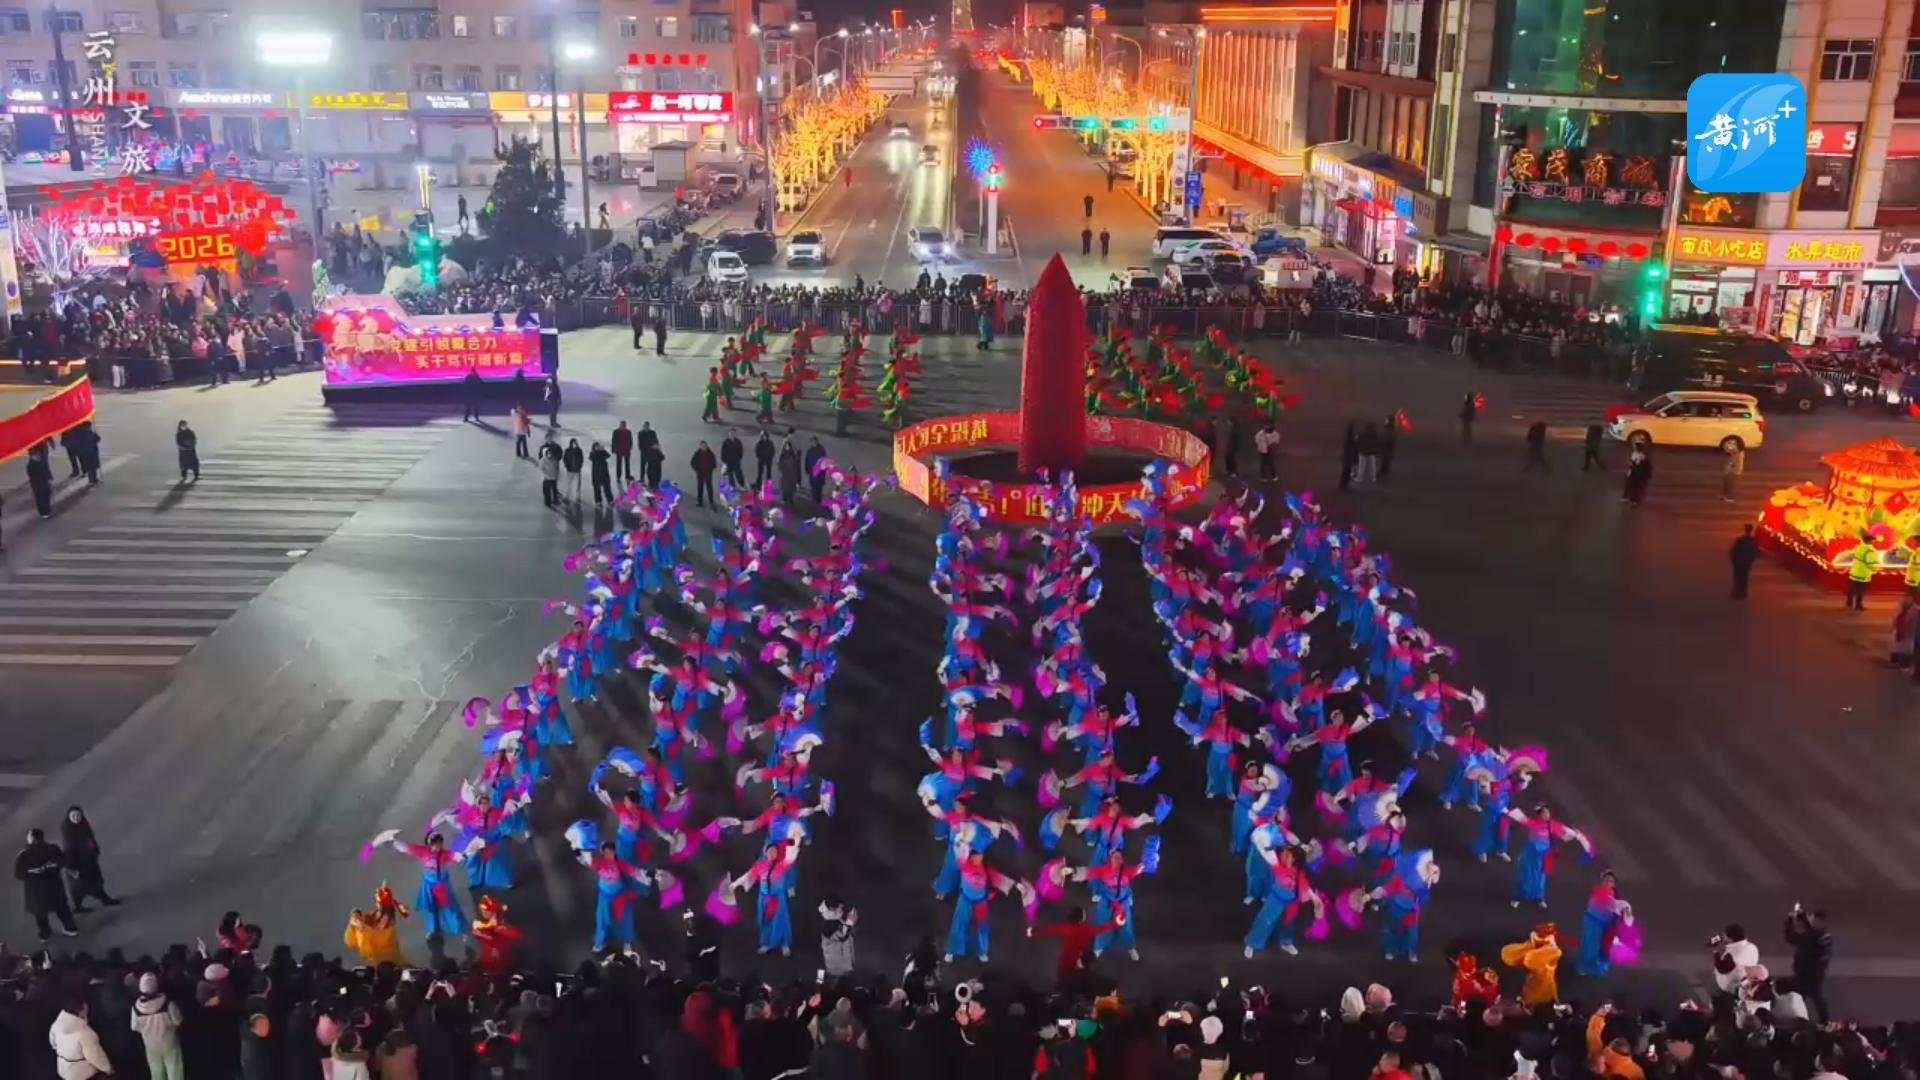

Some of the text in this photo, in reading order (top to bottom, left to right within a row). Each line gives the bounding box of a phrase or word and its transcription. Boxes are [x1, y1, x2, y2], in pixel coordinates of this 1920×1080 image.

[160, 233, 234, 261] 2026
[1680, 236, 1765, 260] 面皮小吃店
